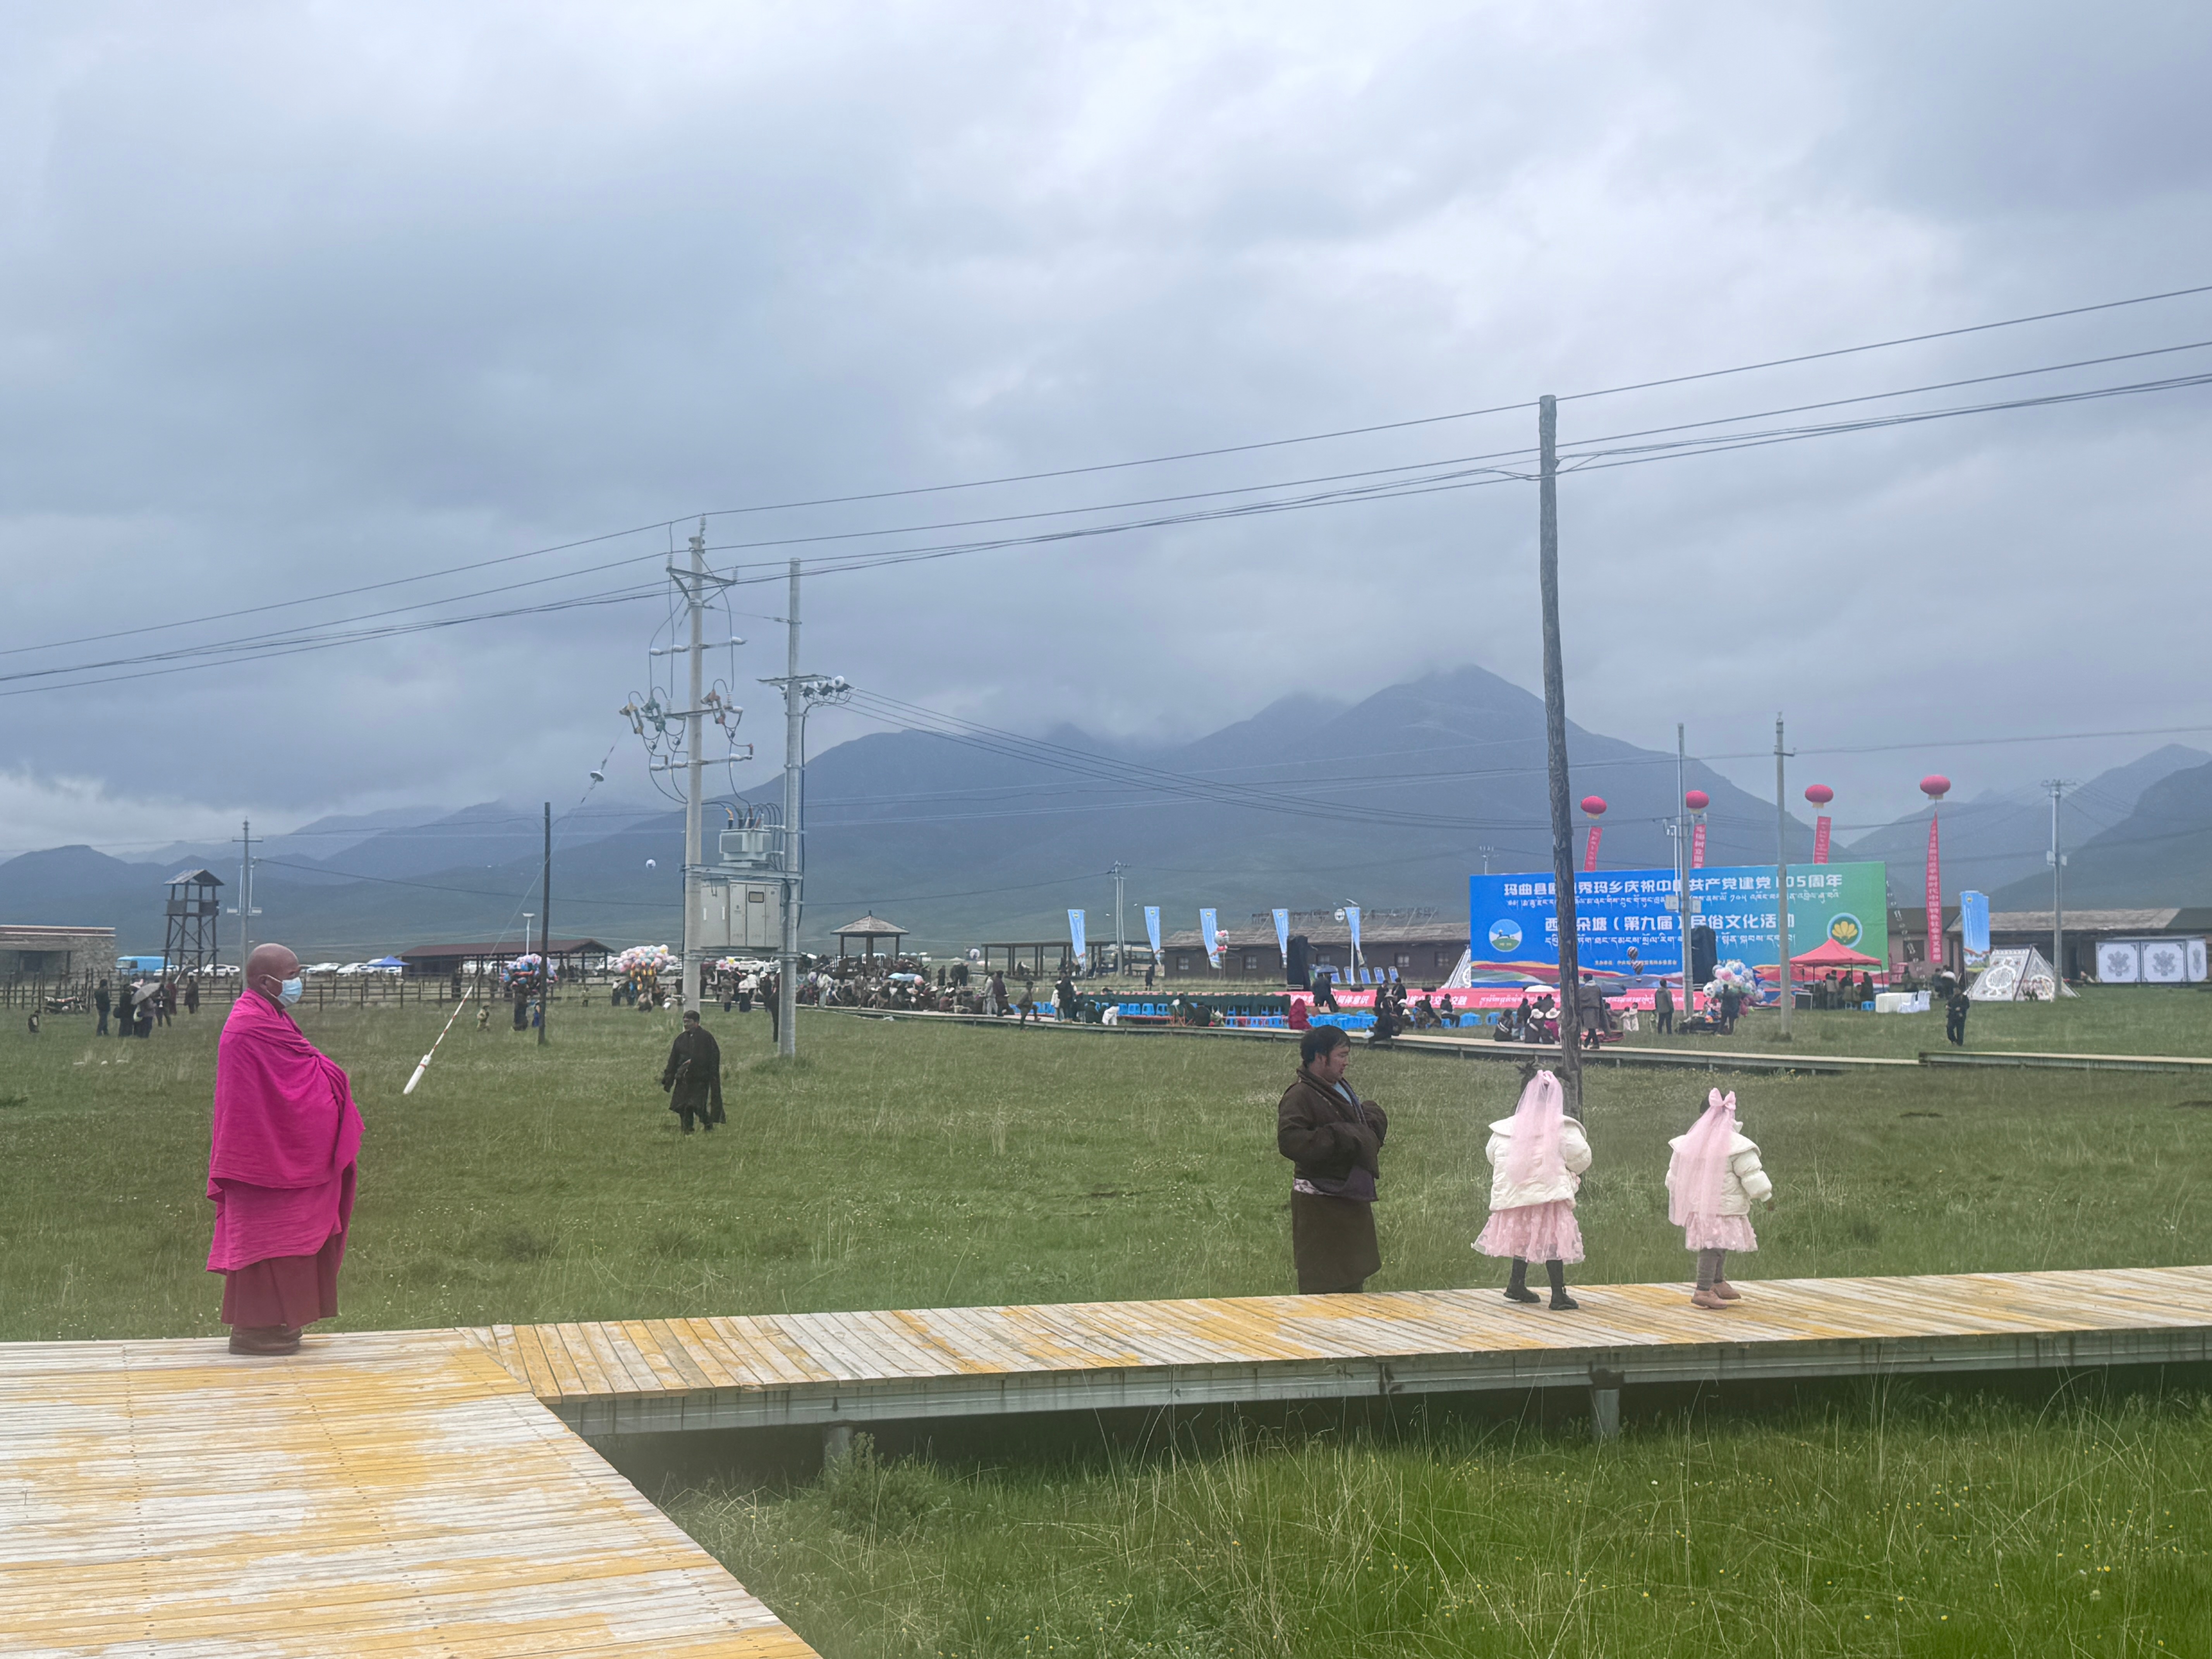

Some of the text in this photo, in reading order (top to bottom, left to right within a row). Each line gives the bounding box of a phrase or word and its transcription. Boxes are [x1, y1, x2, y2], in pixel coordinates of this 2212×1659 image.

[1504, 874, 1843, 895] 玛曲县秀玛乡庆祝中共产党建党105周年
[1545, 914, 1795, 931] 西朵塘（第九届）民俗文化活
